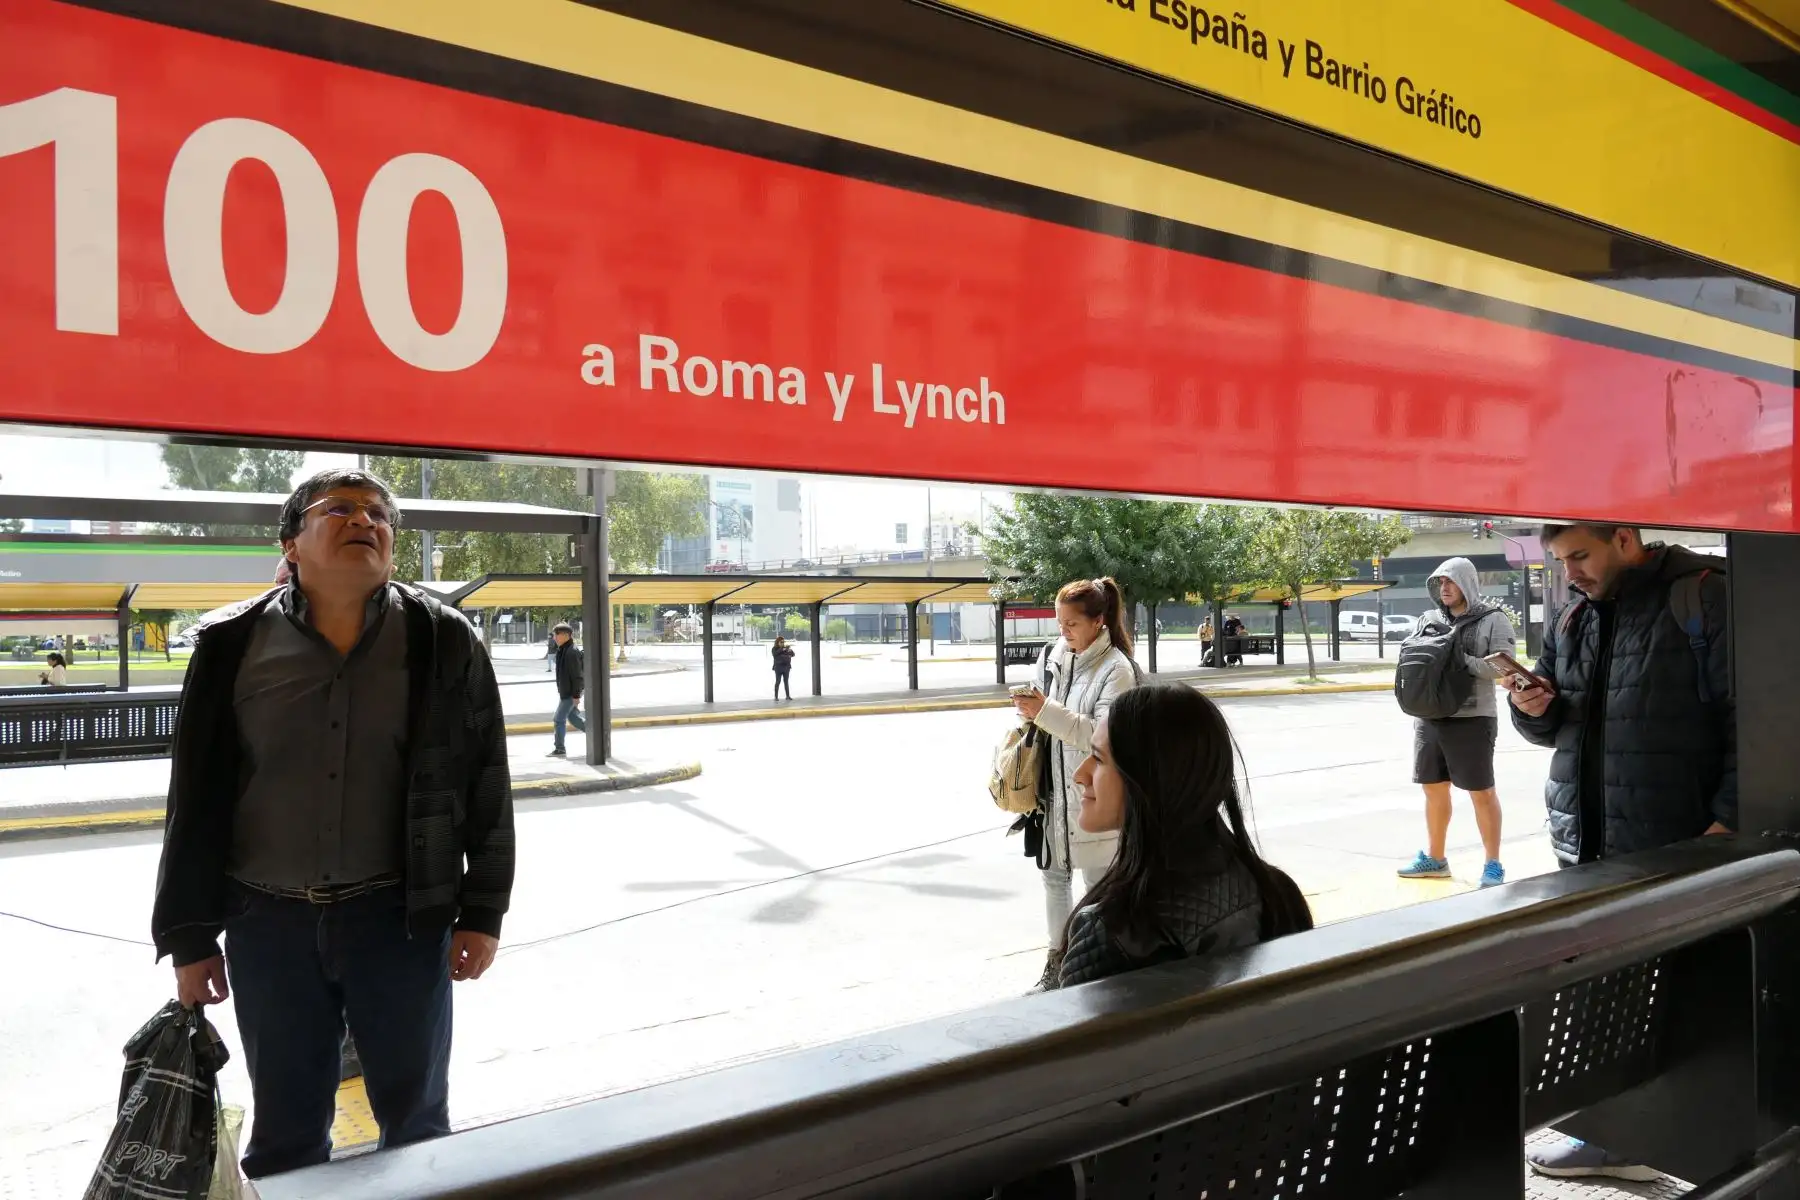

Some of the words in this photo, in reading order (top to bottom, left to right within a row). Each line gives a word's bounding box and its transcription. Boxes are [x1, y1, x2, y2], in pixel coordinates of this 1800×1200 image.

[1277, 37, 1296, 78] y
[1305, 38, 1387, 104] Barrio
[1395, 75, 1482, 139] Gráfico
[0, 87, 509, 373] 100
[580, 342, 616, 387] a
[639, 333, 807, 406] Roma
[824, 370, 855, 422] y
[872, 362, 1006, 429] Lynch
